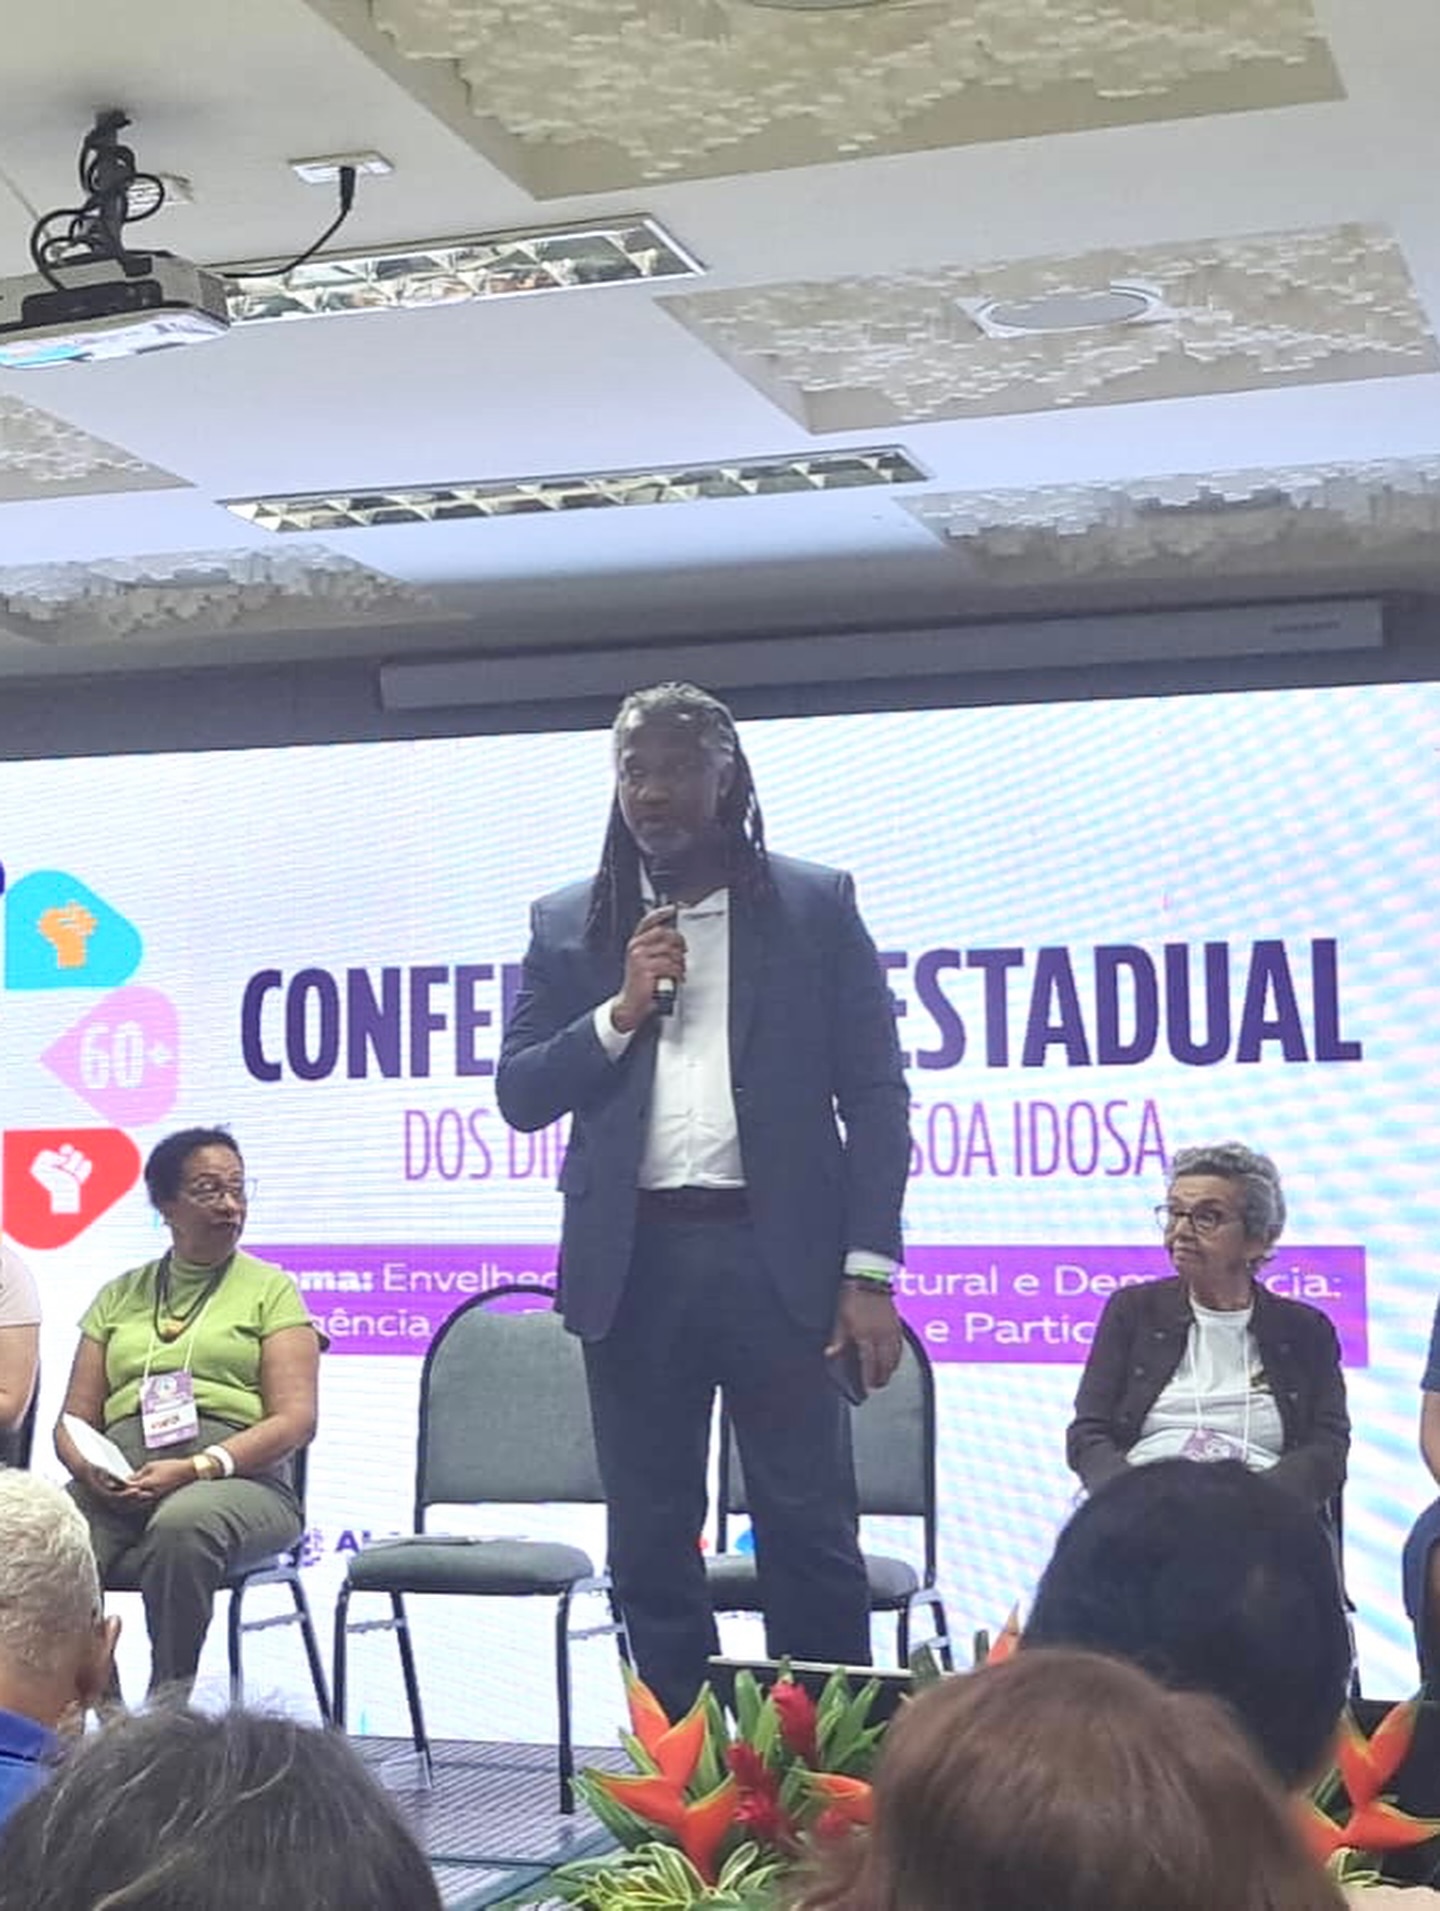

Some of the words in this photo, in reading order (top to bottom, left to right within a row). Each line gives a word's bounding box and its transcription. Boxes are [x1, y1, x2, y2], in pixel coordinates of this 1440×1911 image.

[82, 1021, 172, 1089] 60+
[404, 1108, 494, 1180] DOS
[1014, 1099, 1168, 1177] IDOSA
[1012, 1274, 1040, 1296] e
[924, 1319, 950, 1343] e
